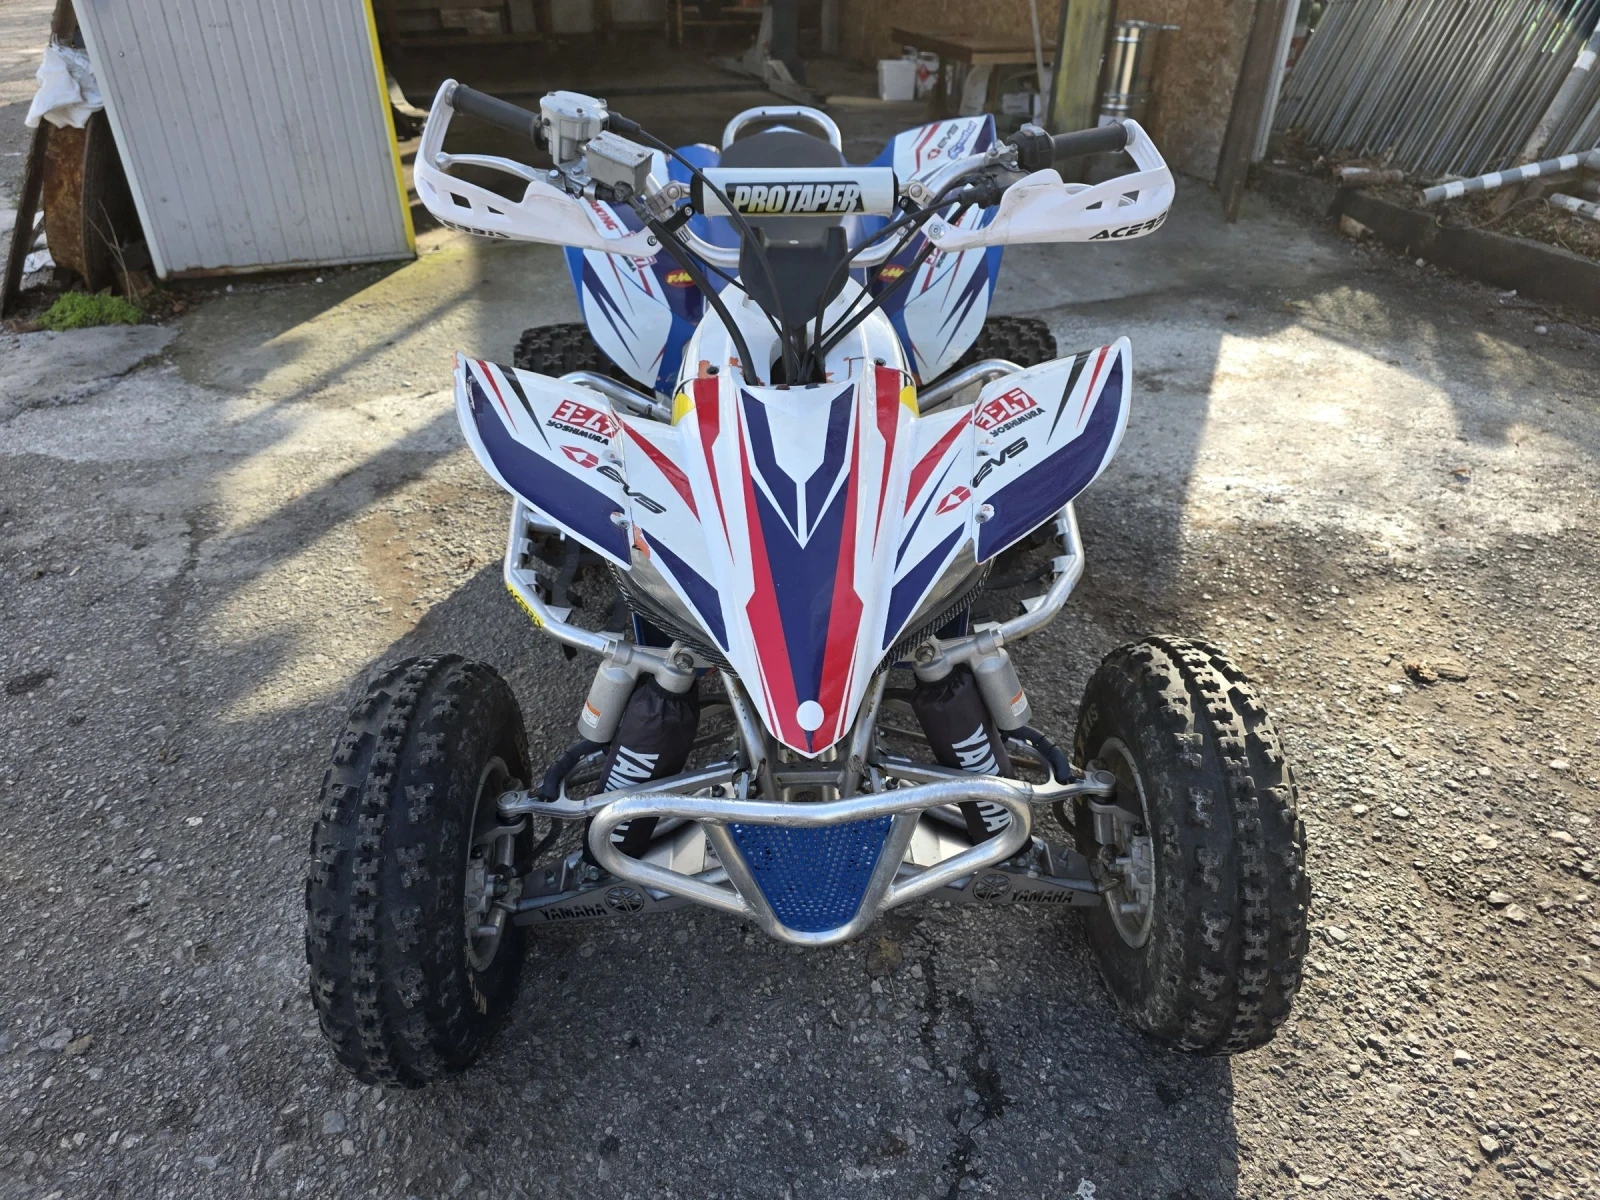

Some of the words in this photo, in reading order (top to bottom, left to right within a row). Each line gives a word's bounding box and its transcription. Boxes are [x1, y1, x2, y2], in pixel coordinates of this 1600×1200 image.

[733, 183, 861, 213] PROTAPER
[546, 420, 609, 446] YOSHIMURA
[989, 407, 1046, 437] YOSHIMURA
[970, 436, 1029, 488] EVS
[596, 465, 667, 514] EVS
[540, 903, 608, 920] YAMAHA
[1011, 890, 1075, 903] YAMAHA
